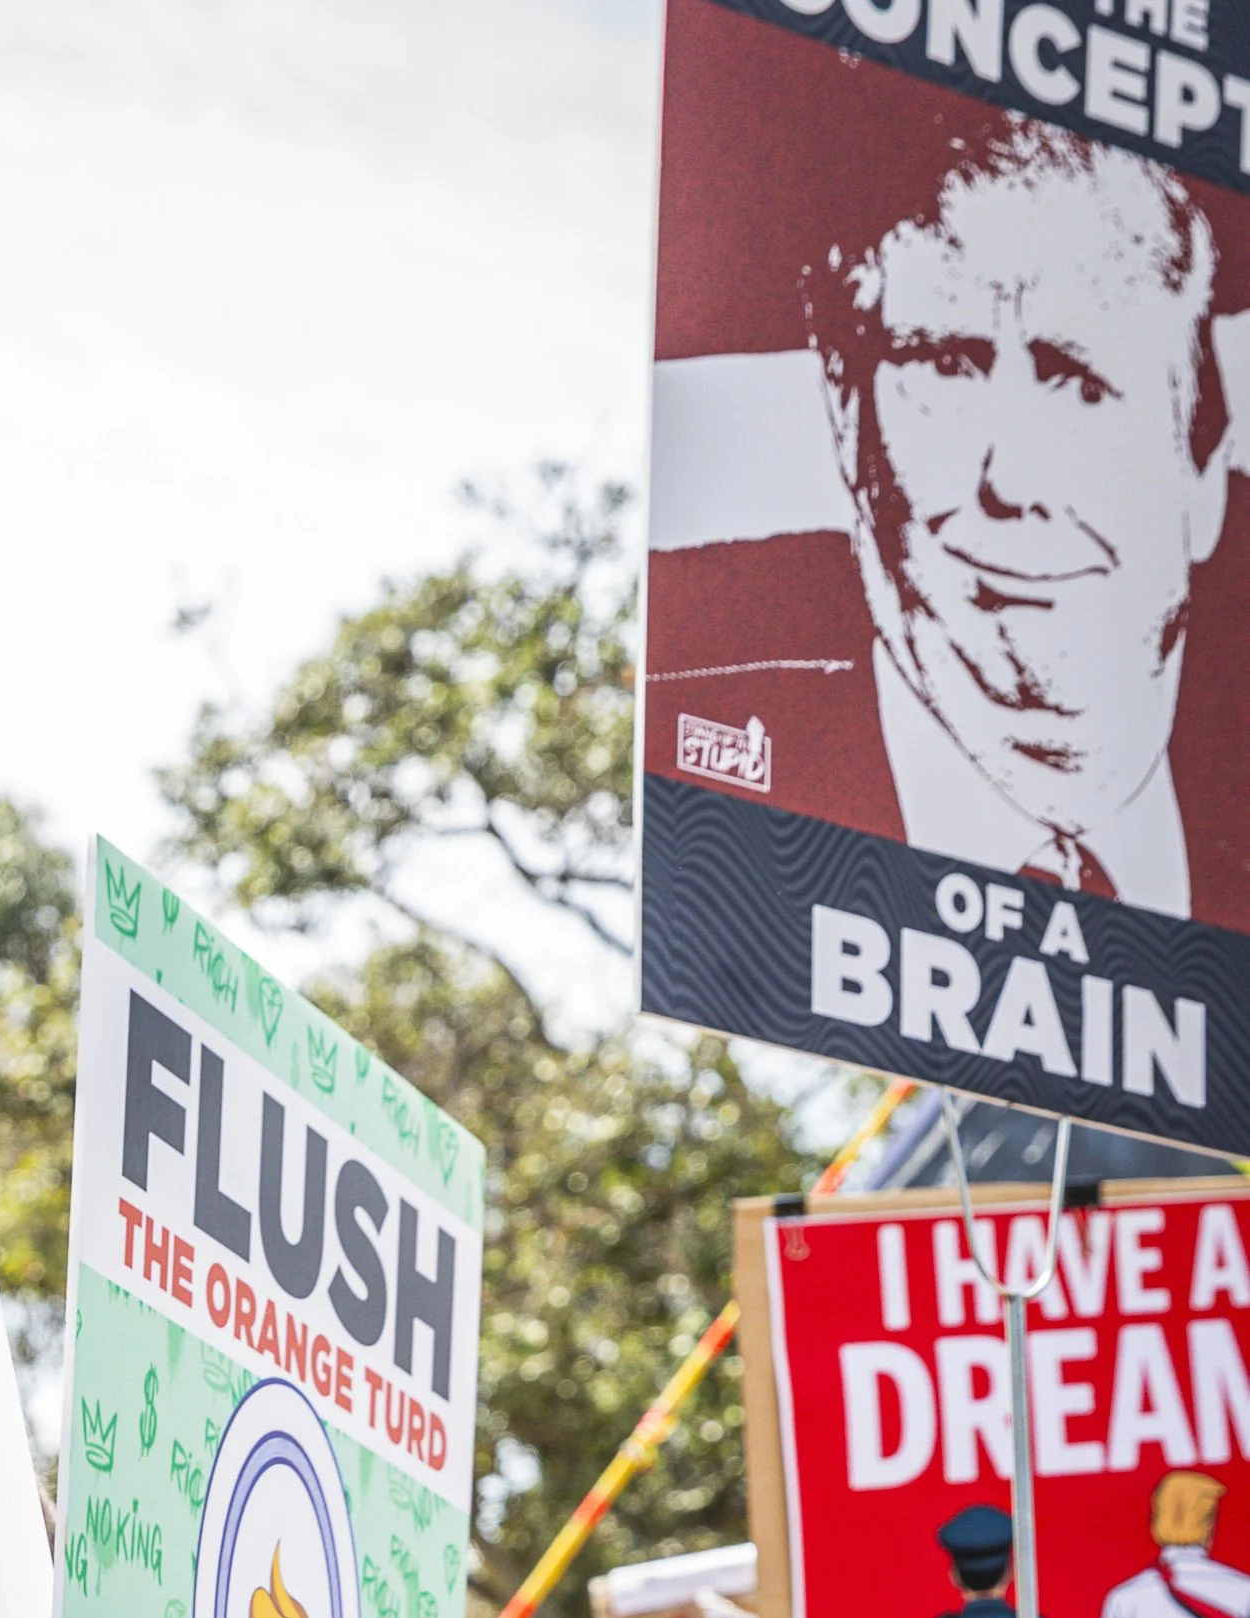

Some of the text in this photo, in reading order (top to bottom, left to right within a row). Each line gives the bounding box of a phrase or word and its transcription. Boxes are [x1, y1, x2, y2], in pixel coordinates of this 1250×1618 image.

[773, 0, 1250, 176] NCEP
[811, 903, 1207, 1109] BRAIN
[936, 873, 1090, 963] OF A
[121, 988, 456, 1401] FLUSH
[877, 1203, 1250, 1331] I HAVE A
[119, 1196, 447, 1472] THE ORANGE TURD
[86, 1494, 112, 1547] NO
